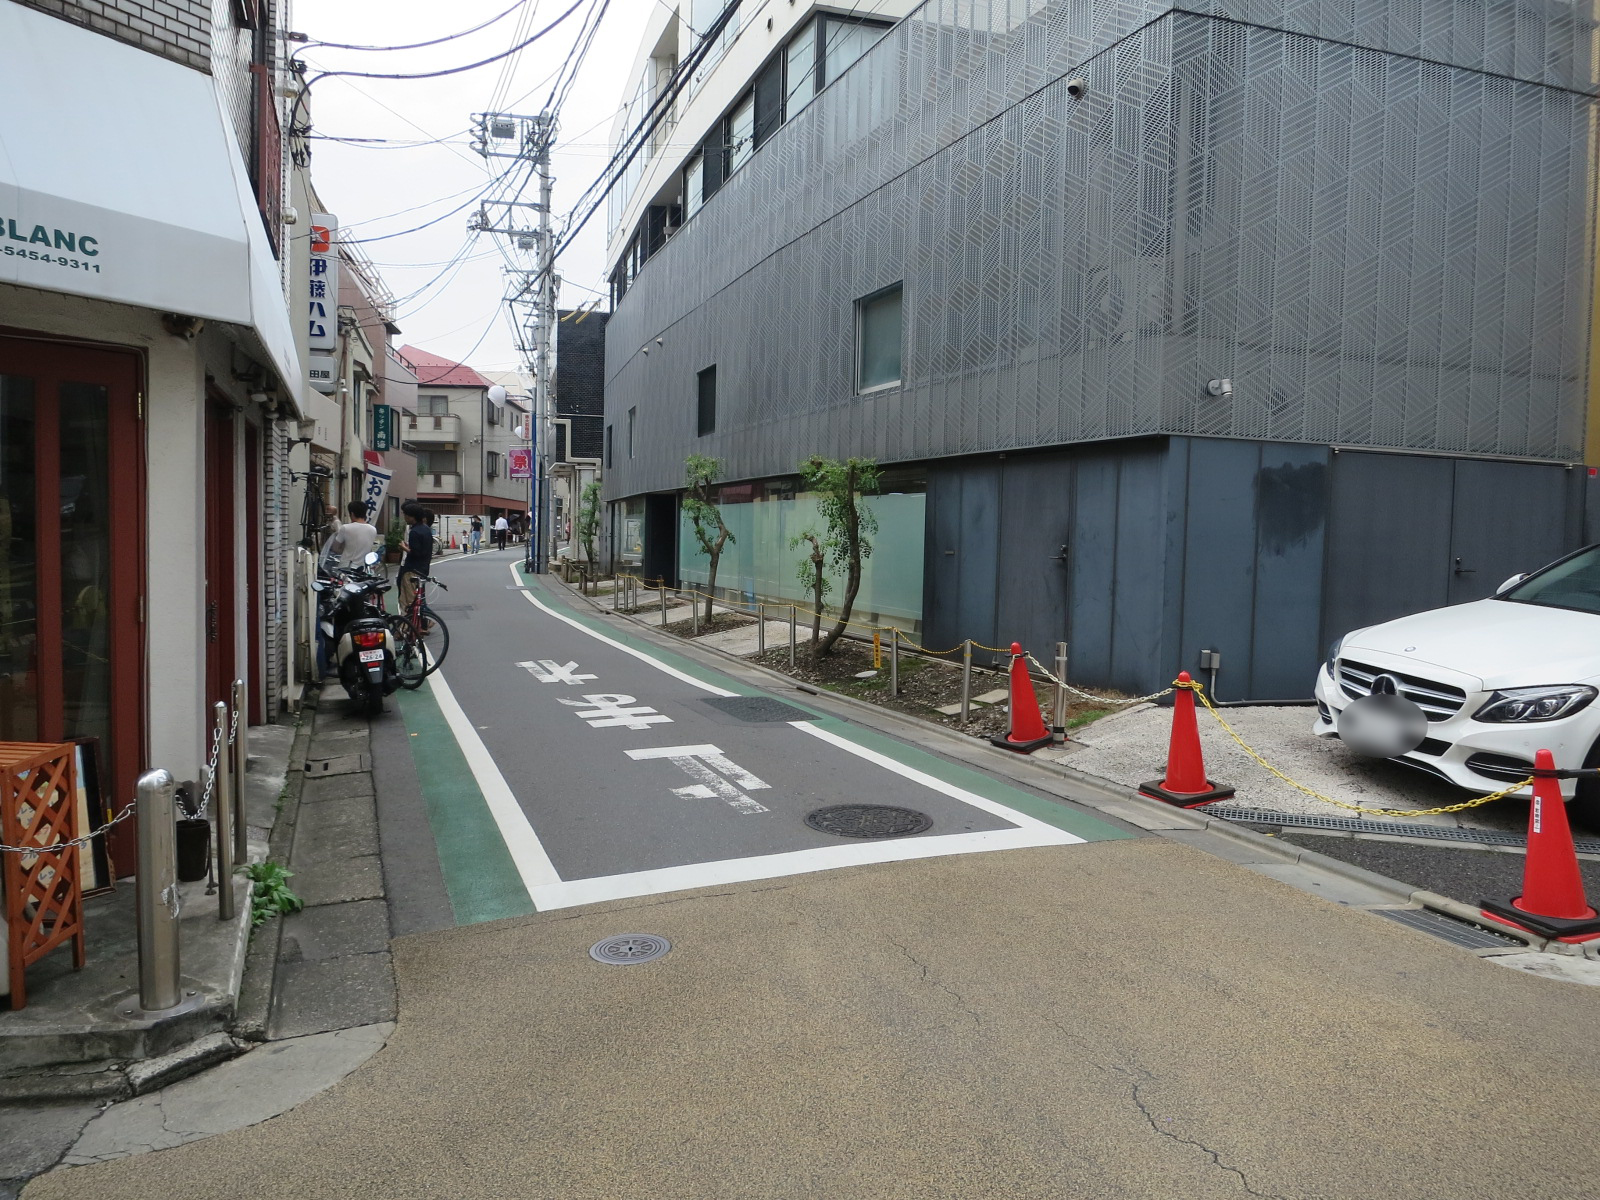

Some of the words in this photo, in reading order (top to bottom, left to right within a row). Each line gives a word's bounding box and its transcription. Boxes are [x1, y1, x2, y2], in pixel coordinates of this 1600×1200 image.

[0, 217, 99, 256] LANC
[310, 259, 327, 337] 伊藤ハム
[514, 659, 772, 815] 止まれ
